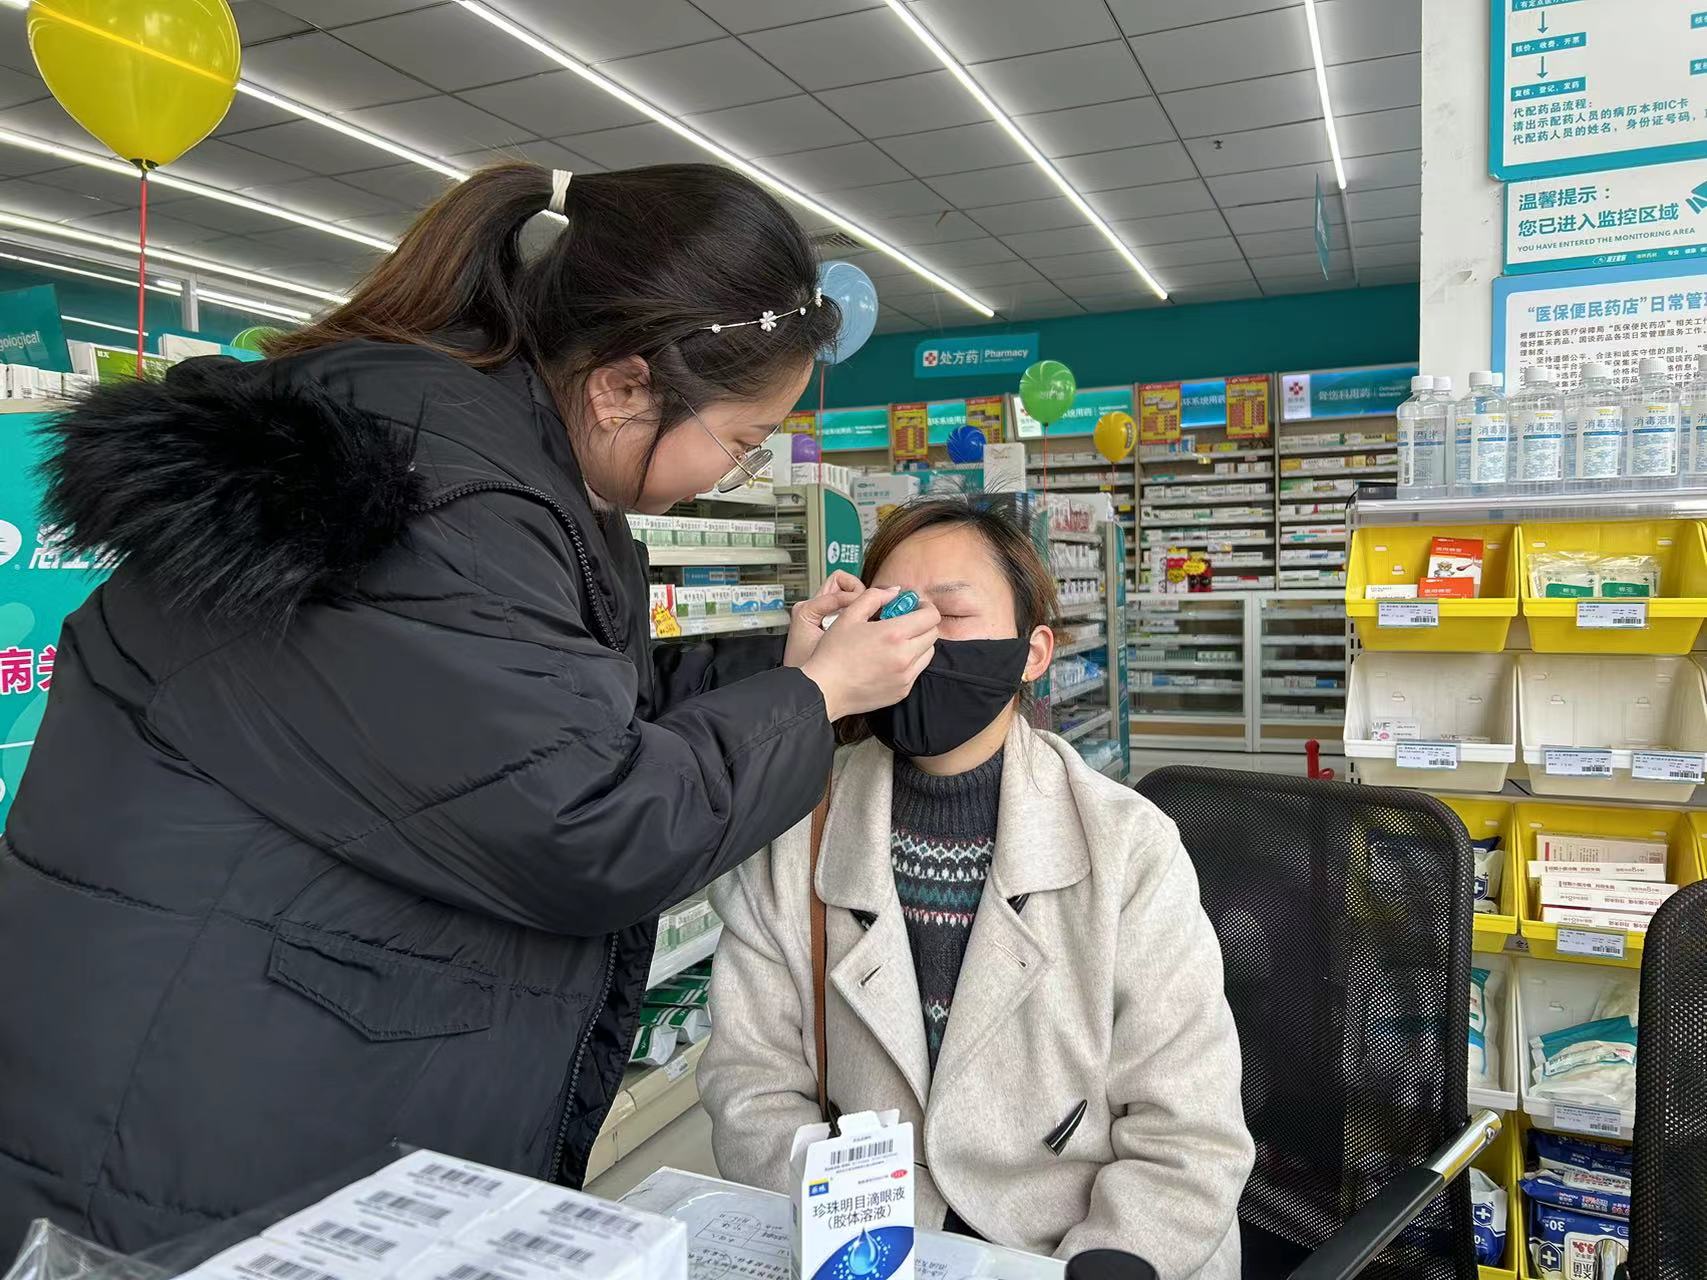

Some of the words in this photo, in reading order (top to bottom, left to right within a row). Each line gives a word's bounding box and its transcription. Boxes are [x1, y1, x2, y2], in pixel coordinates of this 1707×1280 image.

[1518, 185, 1610, 212] 温馨提示：
[1518, 203, 1680, 238] 您已进入监控区域
[1517, 244, 1535, 253] YOU
[1536, 242, 1557, 250] HAVE
[1559, 238, 1595, 249] ENTERED
[1597, 235, 1613, 244] THE
[1614, 229, 1671, 242] MONITORING
[1673, 227, 1696, 235] AREA
[939, 349, 979, 365] 处方药
[984, 348, 1029, 358] Pharmacy
[812, 1186, 906, 1218] 珍珠明目滴眼液
[827, 1204, 893, 1229] （胶体溶液）
